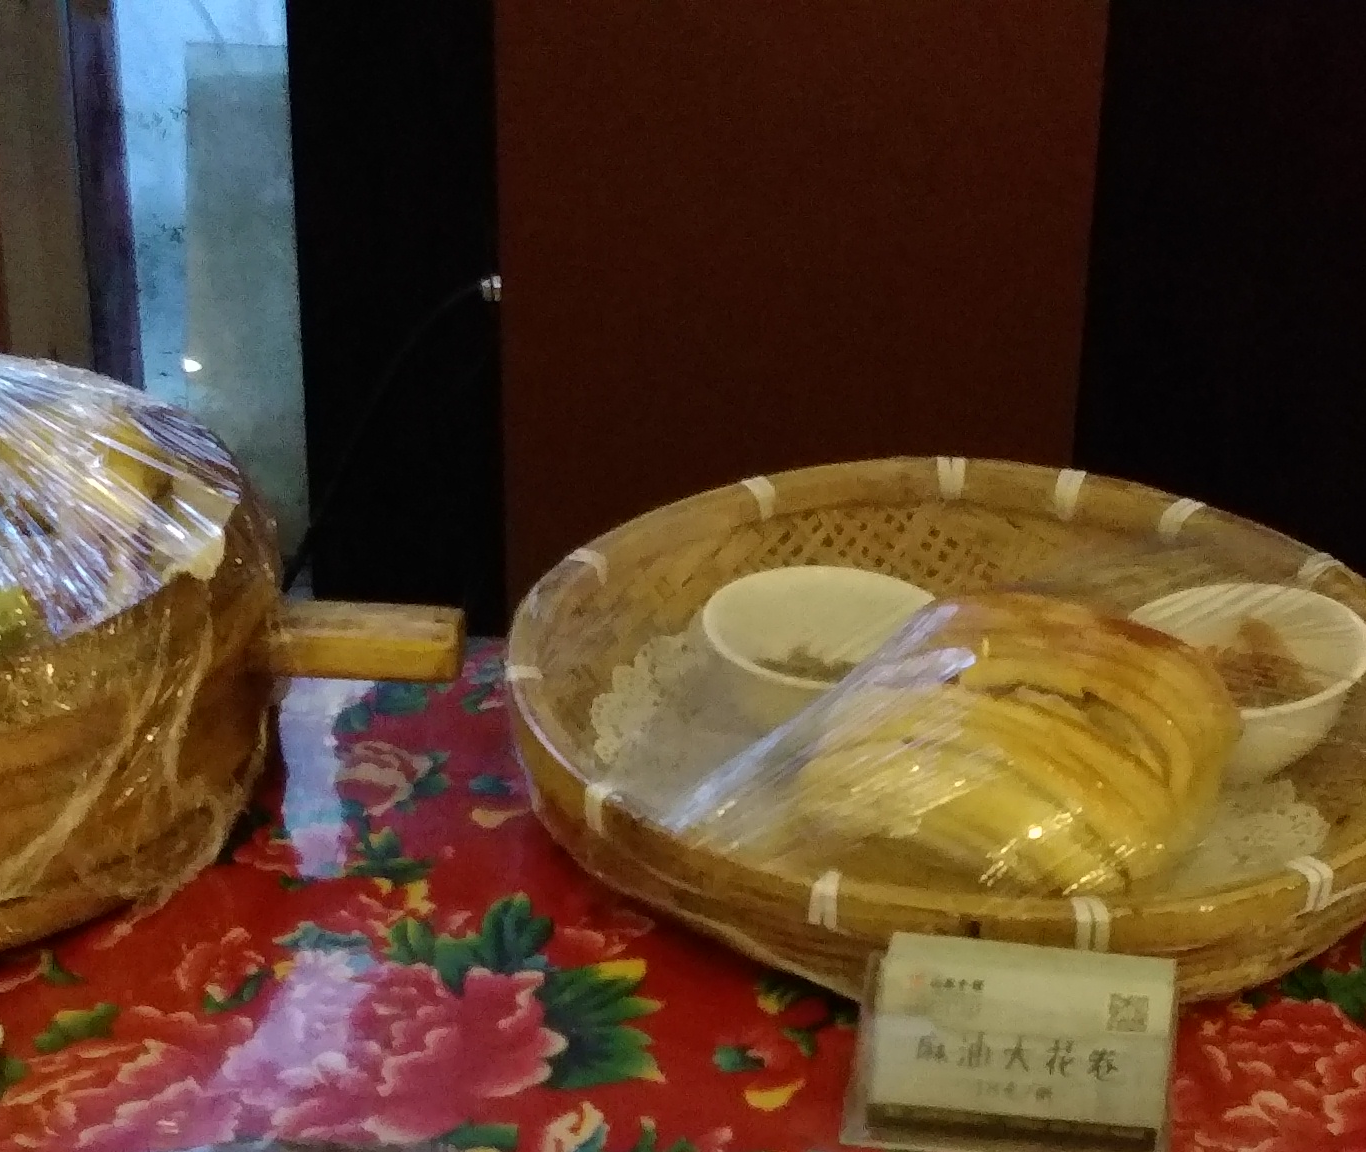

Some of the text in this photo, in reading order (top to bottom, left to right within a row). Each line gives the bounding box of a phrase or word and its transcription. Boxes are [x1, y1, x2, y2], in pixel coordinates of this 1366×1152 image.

[915, 1031, 1120, 1082] 麻油大花卷
